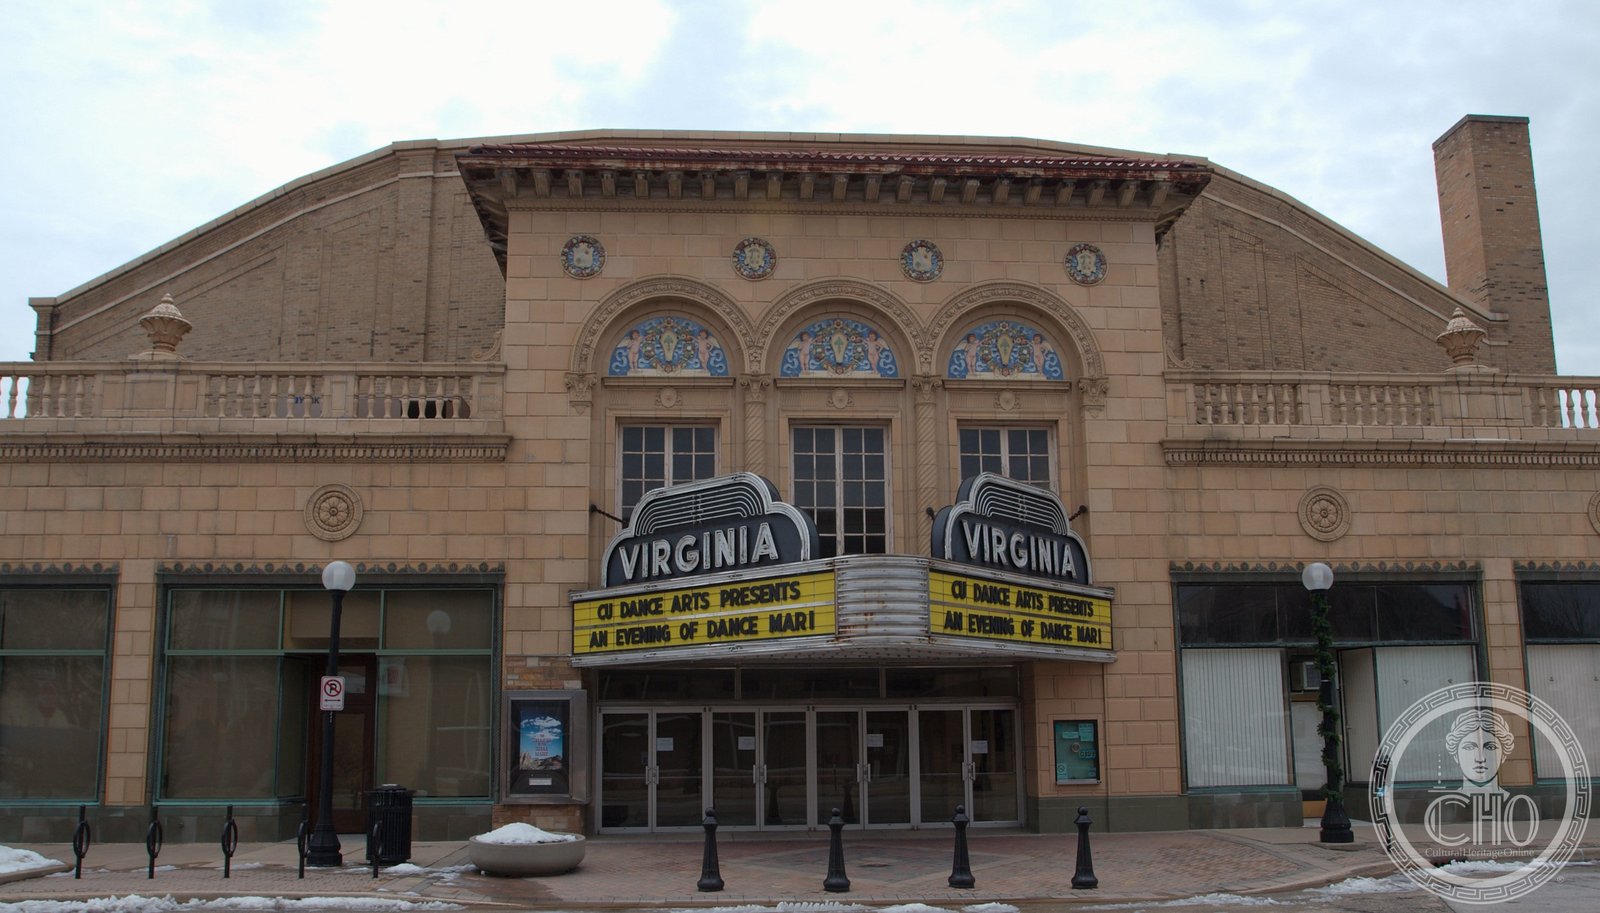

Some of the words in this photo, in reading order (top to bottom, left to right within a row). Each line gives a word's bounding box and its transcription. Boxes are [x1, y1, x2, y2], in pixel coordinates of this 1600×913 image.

[619, 522, 778, 580] VIRGINIA
[962, 520, 1077, 578] VIRGINIA
[597, 603, 612, 619] CU
[620, 597, 663, 618] DANCE
[671, 593, 709, 612] ARTS
[720, 582, 800, 608] PRESENTS
[952, 580, 966, 599] CU
[974, 584, 1010, 606] DANCE
[1016, 590, 1043, 610] ARTS
[1049, 595, 1093, 617] PRESENTS
[590, 630, 607, 648] AN
[616, 625, 670, 645] EVENING
[680, 622, 698, 639] OF
[707, 616, 758, 638] DANCE
[945, 611, 962, 630] AN
[969, 614, 1014, 634] EVENING
[1021, 620, 1034, 637] OF
[1041, 623, 1072, 641] DANCE
